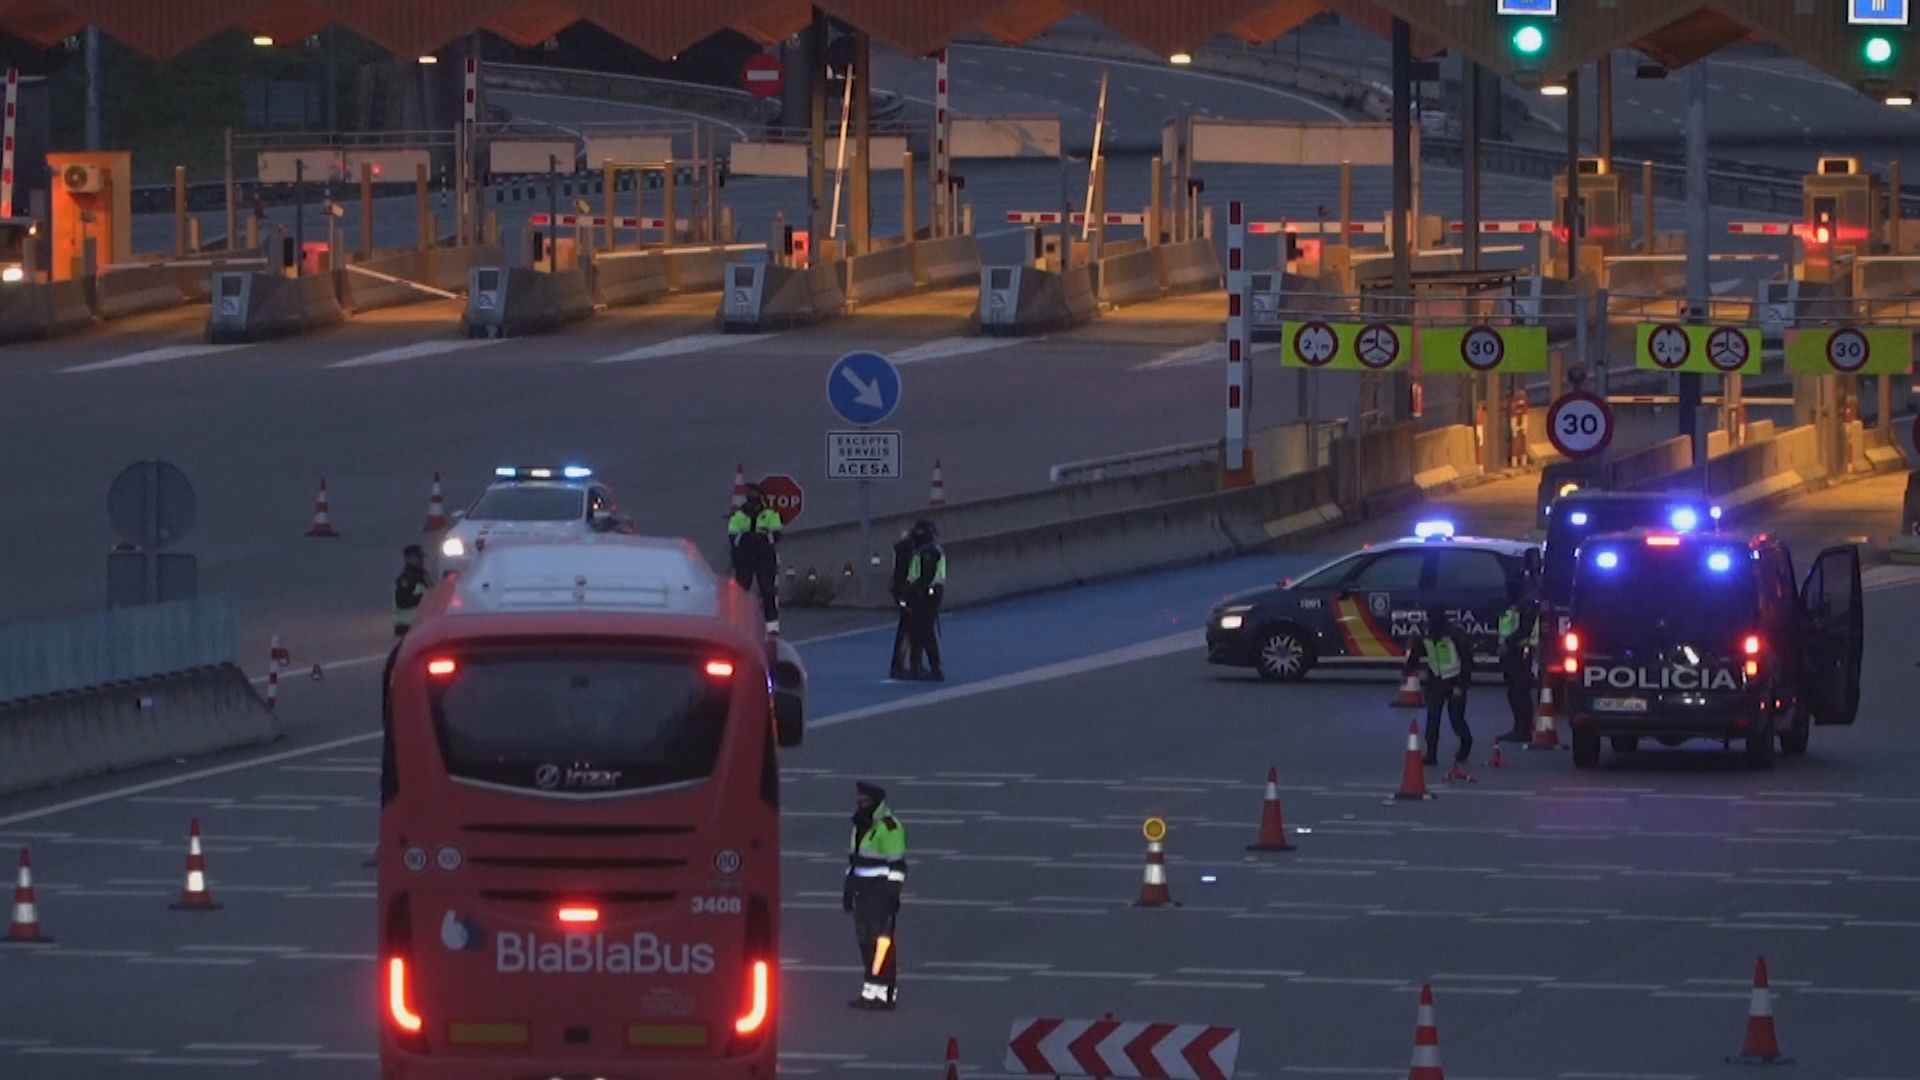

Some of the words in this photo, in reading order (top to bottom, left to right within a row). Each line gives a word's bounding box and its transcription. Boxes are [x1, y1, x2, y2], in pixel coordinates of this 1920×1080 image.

[1471, 340, 1494, 355] 30
[1836, 342, 1860, 357] 30
[1563, 414, 1597, 435] 30
[838, 437, 889, 446] EXCEPTE
[839, 448, 889, 457] SERVEIS
[838, 464, 890, 475] ACESA
[761, 496, 800, 508] TOP
[1583, 665, 1737, 690] POLICIA
[691, 896, 742, 913] 3408
[496, 931, 715, 974] BlaBlaBus
